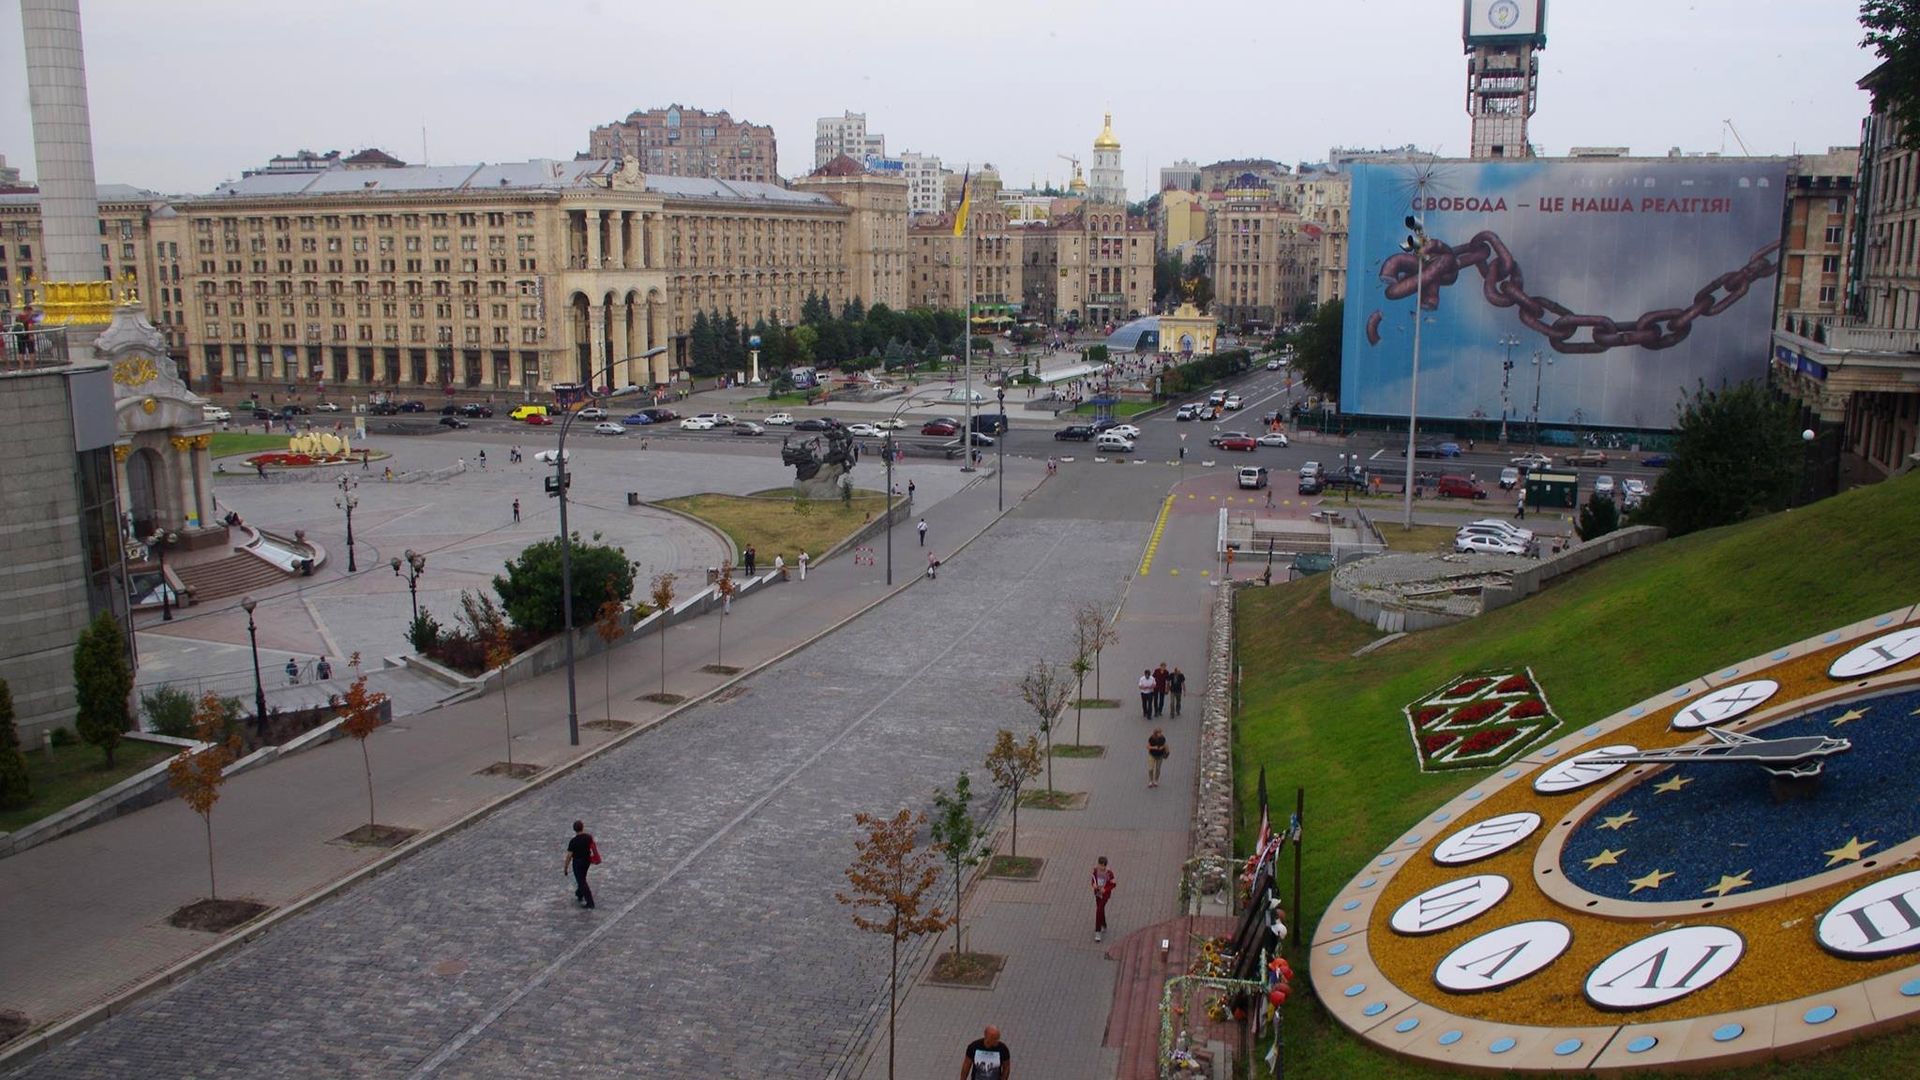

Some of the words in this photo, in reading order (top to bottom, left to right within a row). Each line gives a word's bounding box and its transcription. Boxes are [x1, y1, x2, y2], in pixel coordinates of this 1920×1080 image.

[1412, 197, 1508, 212] СВОБОДА
[1539, 197, 1566, 213] ЦЕ
[1571, 197, 1634, 213] НАША
[1641, 197, 1732, 213] РЕЛІГІЯ!
[1687, 684, 1764, 723] IX
[1443, 816, 1531, 859] VII
[1456, 939, 1532, 980] V
